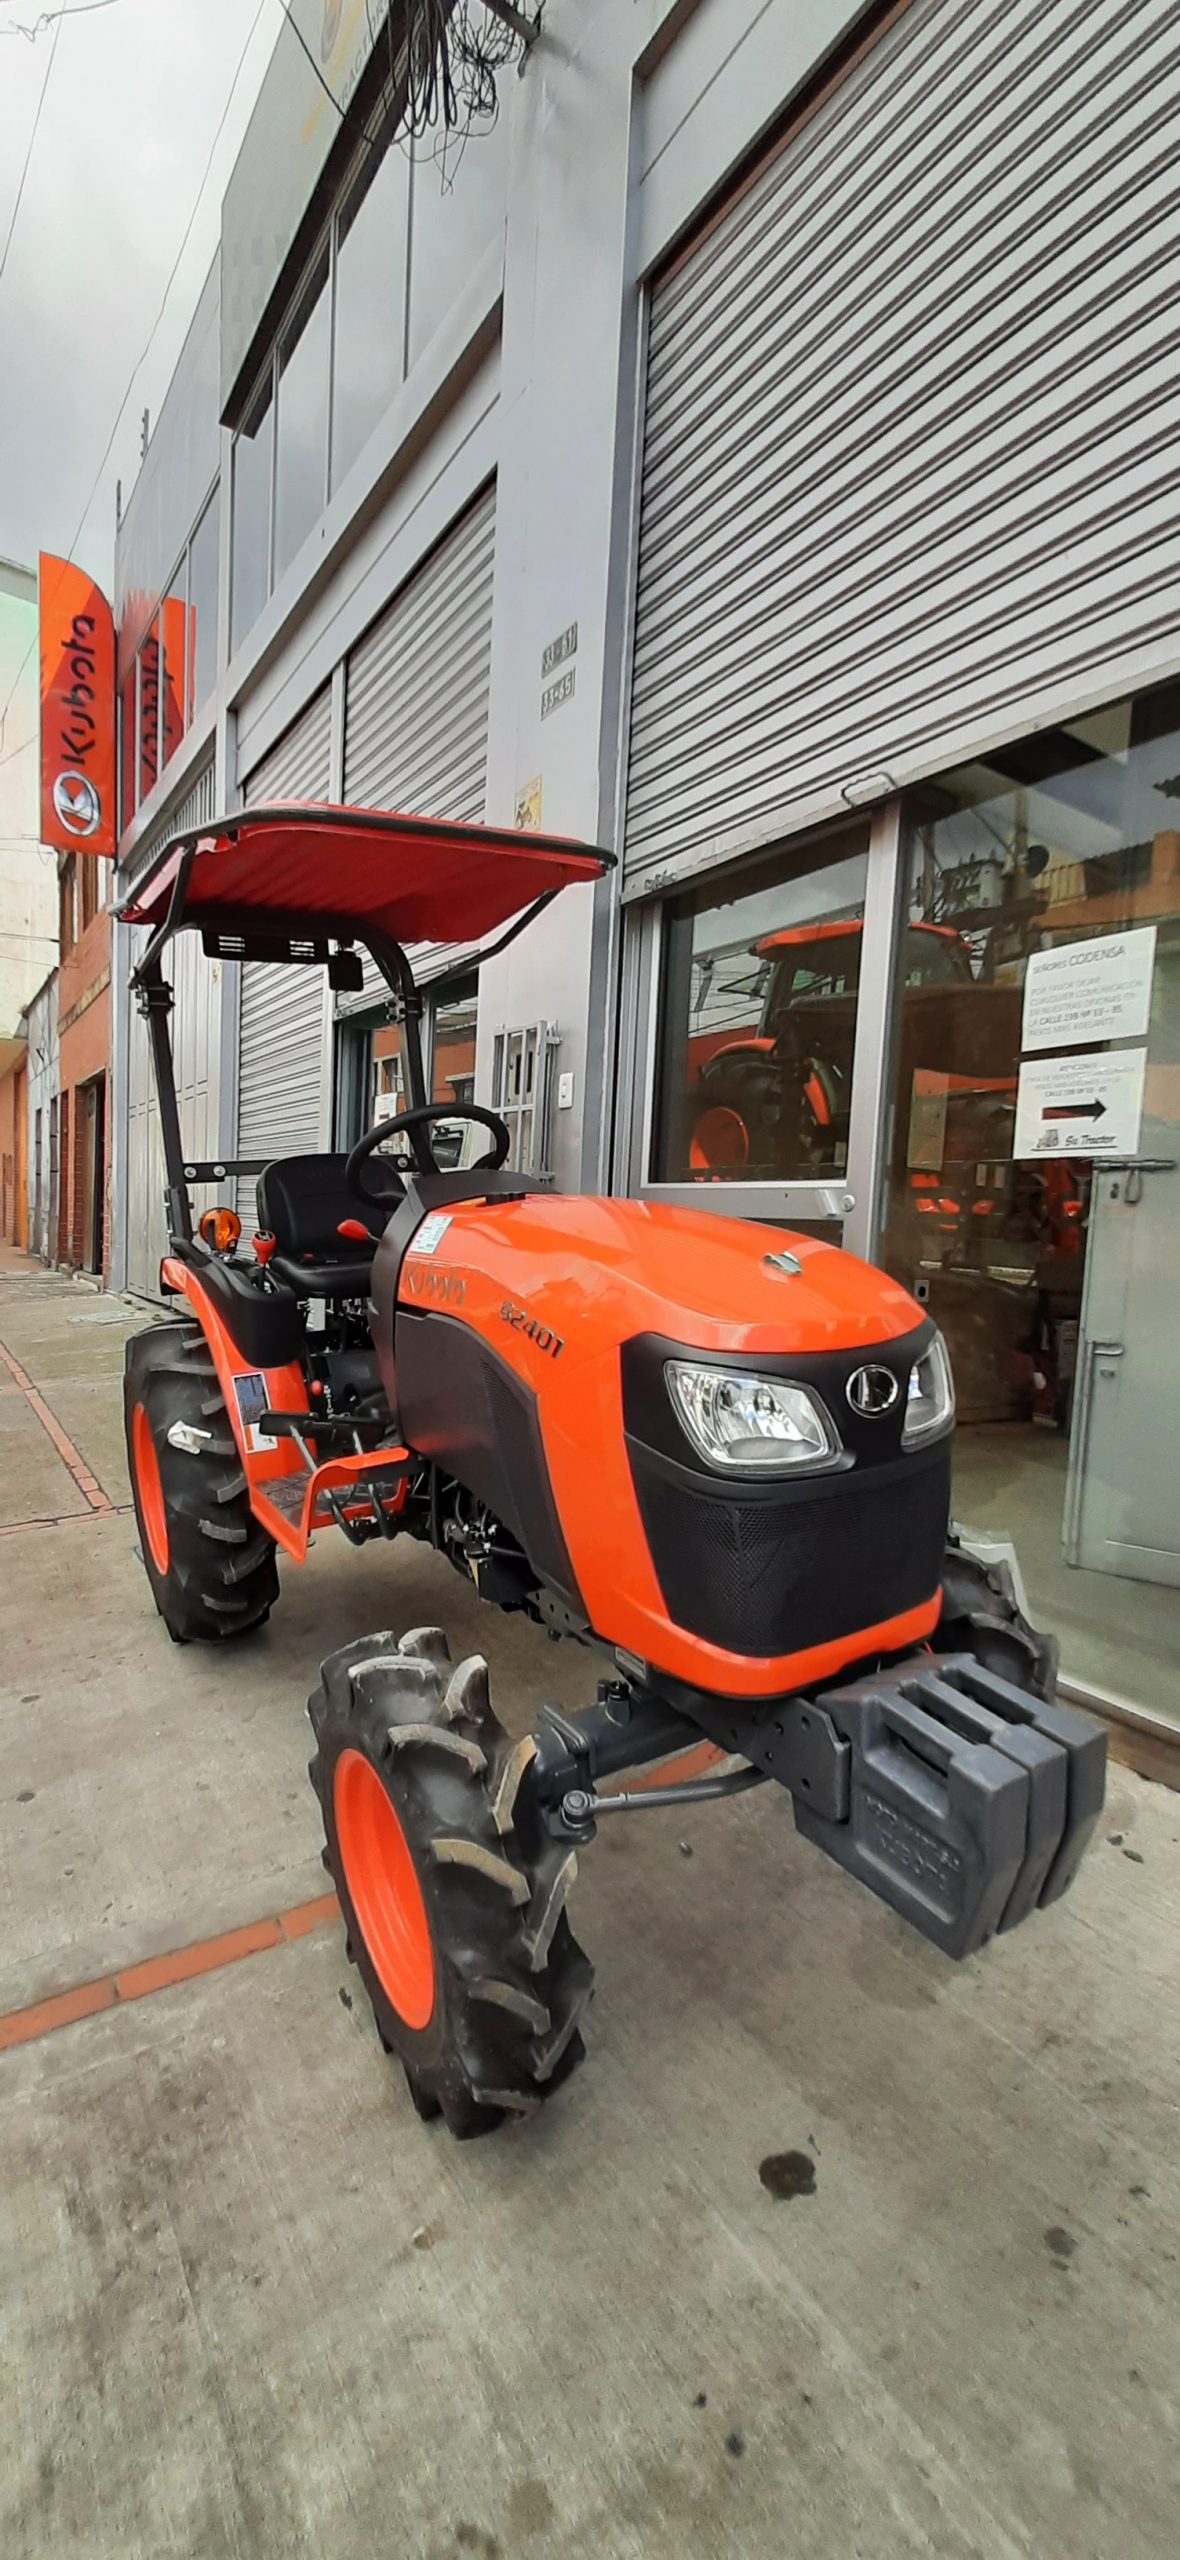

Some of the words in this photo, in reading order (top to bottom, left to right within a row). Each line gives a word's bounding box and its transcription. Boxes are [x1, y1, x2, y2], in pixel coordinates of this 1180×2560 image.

[61, 614, 95, 764] Kubota
[1069, 945, 1125, 967] CODENSA
[1065, 1135, 1079, 1147] Su
[1081, 1134, 1117, 1146] Tractor
